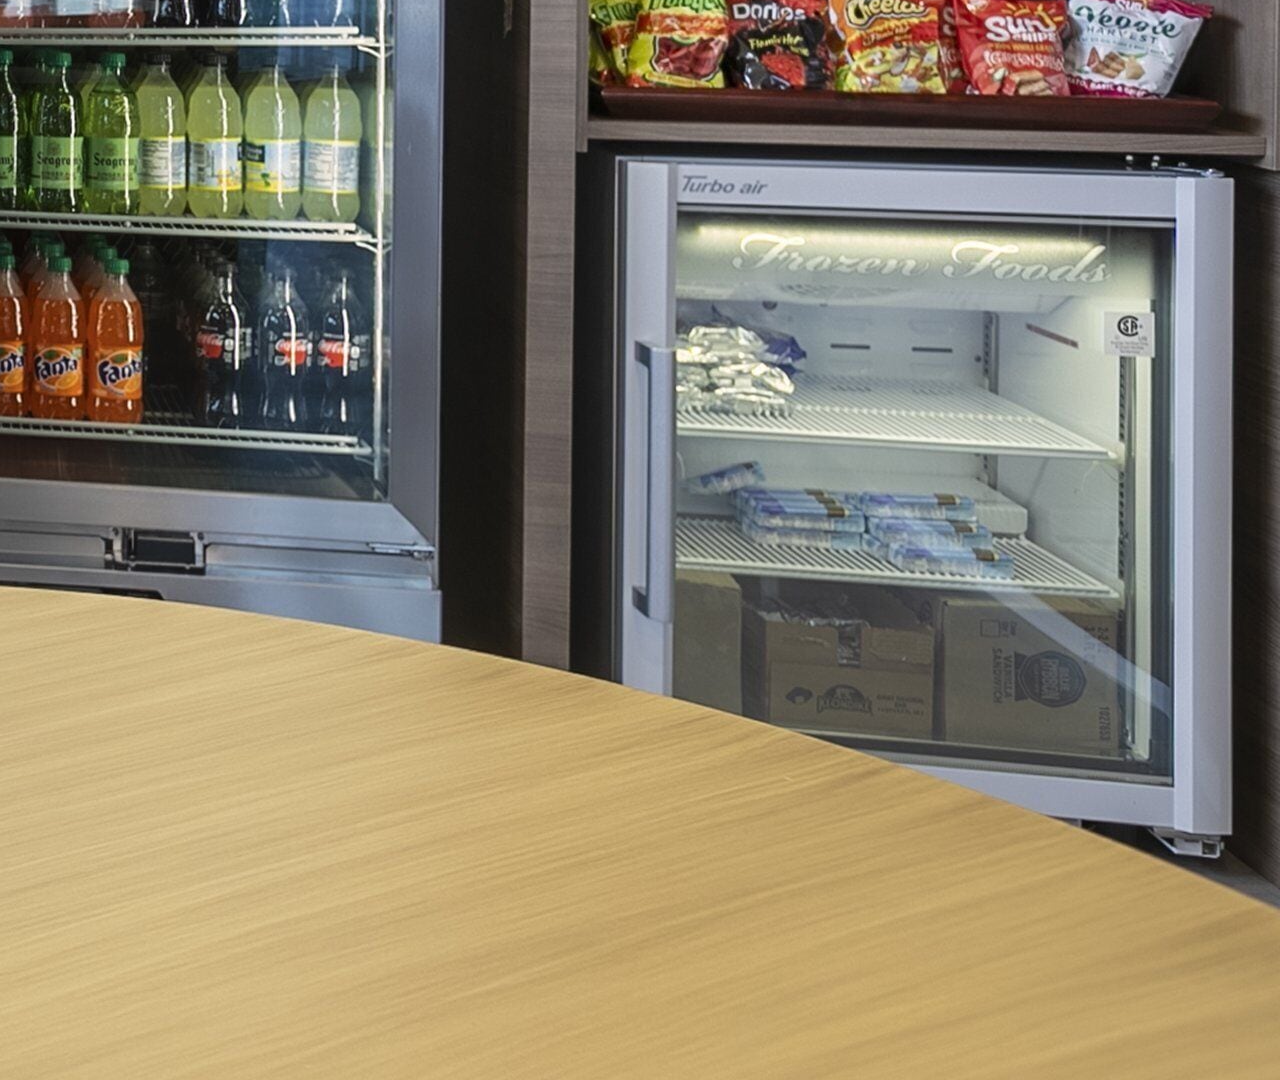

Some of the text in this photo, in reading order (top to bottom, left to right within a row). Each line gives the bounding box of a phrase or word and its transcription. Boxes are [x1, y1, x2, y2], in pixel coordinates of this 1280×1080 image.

[732, 2, 807, 21] Doritos
[984, 15, 1057, 43] Sun
[1012, 31, 1057, 42] CHIPS
[1086, 25, 1161, 44] HARVEST
[682, 175, 768, 195] Turbo air
[732, 233, 1112, 285] Frozen Foods
[35, 354, 78, 381] Fanta
[992, 647, 1003, 704] SANDWICH
